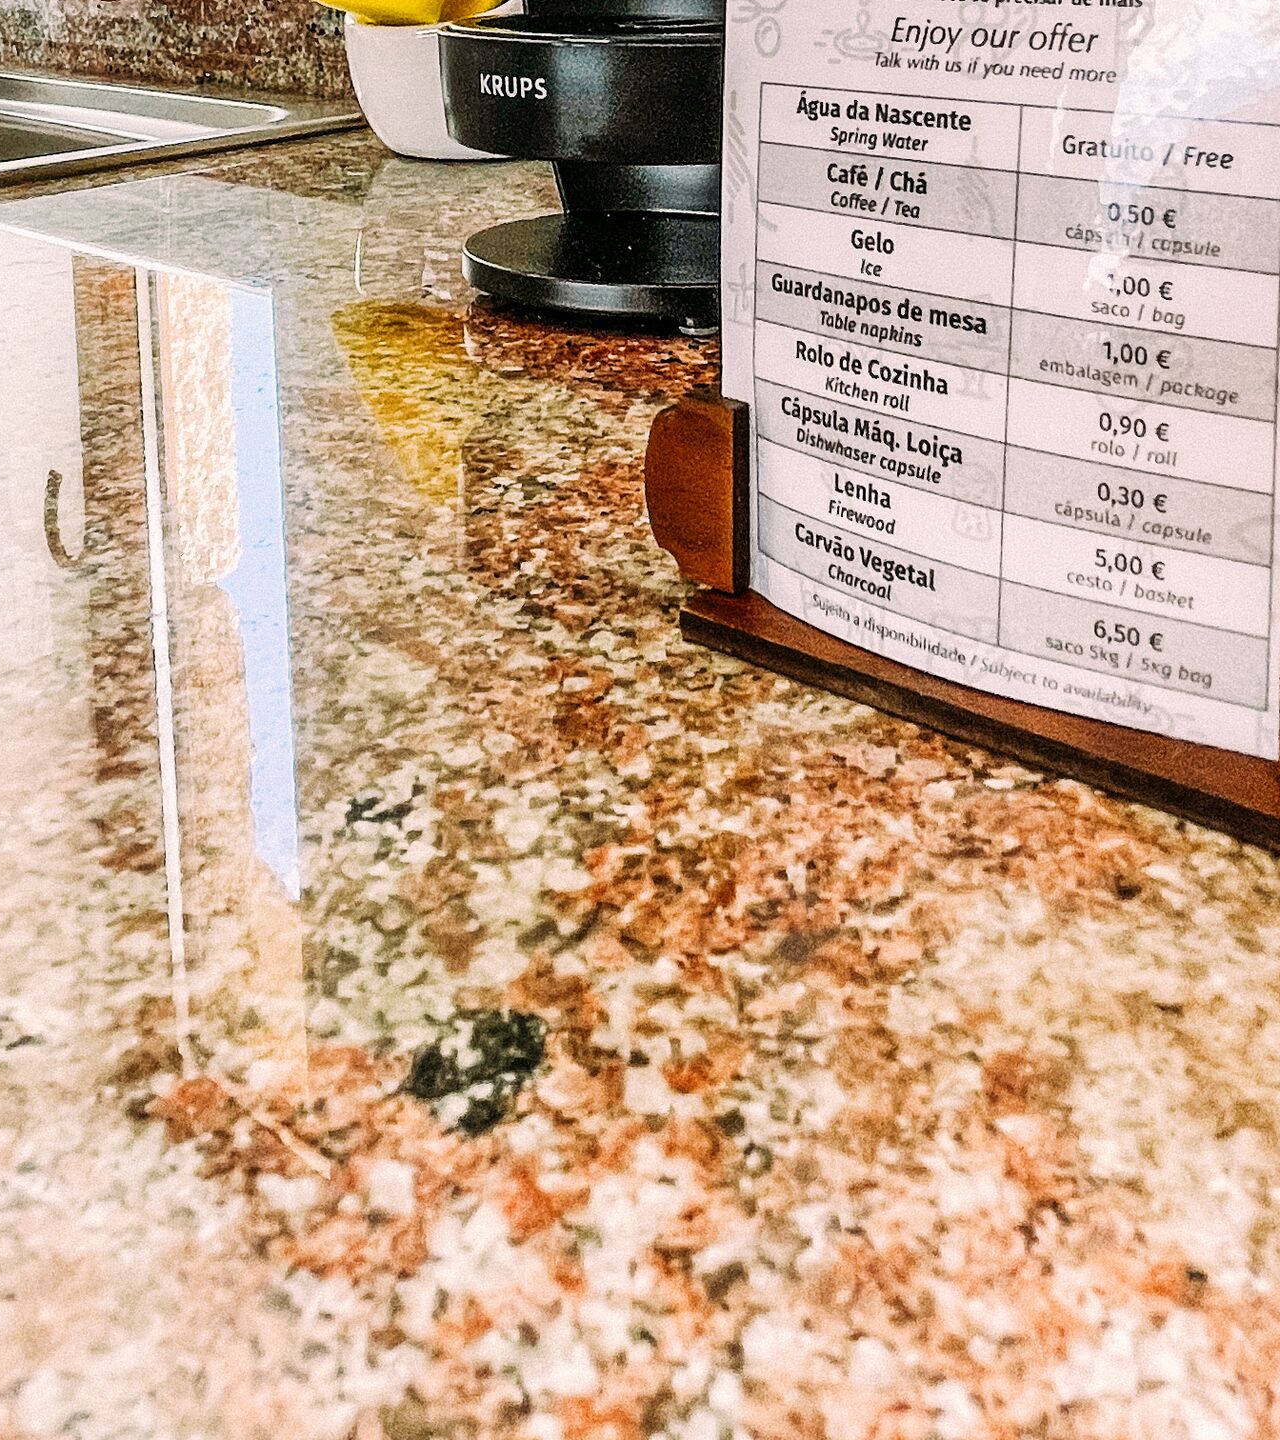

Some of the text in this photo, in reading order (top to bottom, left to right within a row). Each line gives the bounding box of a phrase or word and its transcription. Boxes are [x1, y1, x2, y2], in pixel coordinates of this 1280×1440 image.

[891, 16, 1099, 54] Enjoy our offer
[874, 51, 1117, 83] Talk with us if you need more
[479, 73, 548, 100] KRUPS
[796, 90, 972, 131] Água da Nascente
[830, 126, 929, 151] Spring Water
[1062, 134, 1234, 169] Gratuito / Free
[827, 163, 928, 194] Café / Chá
[831, 191, 877, 212] Coffee
[894, 200, 920, 219] Tea
[1163, 209, 1177, 229] €
[850, 229, 894, 255] Gelo
[1065, 224, 1130, 246] cáps
[1152, 237, 1220, 257] capsule
[860, 258, 883, 277] Ice
[772, 273, 987, 334] Guardanapos de mesa
[1159, 281, 1173, 300] €
[820, 310, 923, 348] Table napkins
[1091, 301, 1130, 318] saco
[1152, 308, 1185, 329] bag
[796, 341, 948, 395] Rolo de Cozinha
[1103, 342, 1172, 369] 1,00 €
[825, 376, 910, 412] Kitchen roll
[1039, 359, 1138, 387] embalagem
[1160, 379, 1239, 405] package
[781, 396, 963, 467] Cápsula Máq. Loiça
[1099, 412, 1170, 442] 0,90 €
[796, 427, 942, 484] Dishwhaser capsule
[1091, 440, 1125, 457] rolo
[1147, 450, 1178, 467] roll
[834, 473, 891, 509] Lenha
[1097, 482, 1168, 513] 0,30 €
[829, 499, 896, 535] Firewood
[1054, 501, 1121, 527] cápsula
[1142, 520, 1212, 545] capsule
[795, 522, 936, 591] Carvão Vegetal
[1095, 548, 1166, 581] 5,00 €
[828, 564, 892, 600] Charcoal
[1067, 571, 1112, 591] cesto
[1134, 583, 1195, 610] basket
[813, 593, 850, 621] Sujeito
[853, 615, 860, 626] a
[864, 617, 966, 664] disponibilidade
[979, 658, 1037, 685] Subject
[1042, 677, 1058, 690] to
[1094, 620, 1163, 652] 6,50 €
[1046, 636, 1083, 656] saco
[1089, 645, 1119, 669] 5kg
[1141, 657, 1172, 680] 5kg
[1178, 665, 1212, 689] bag
